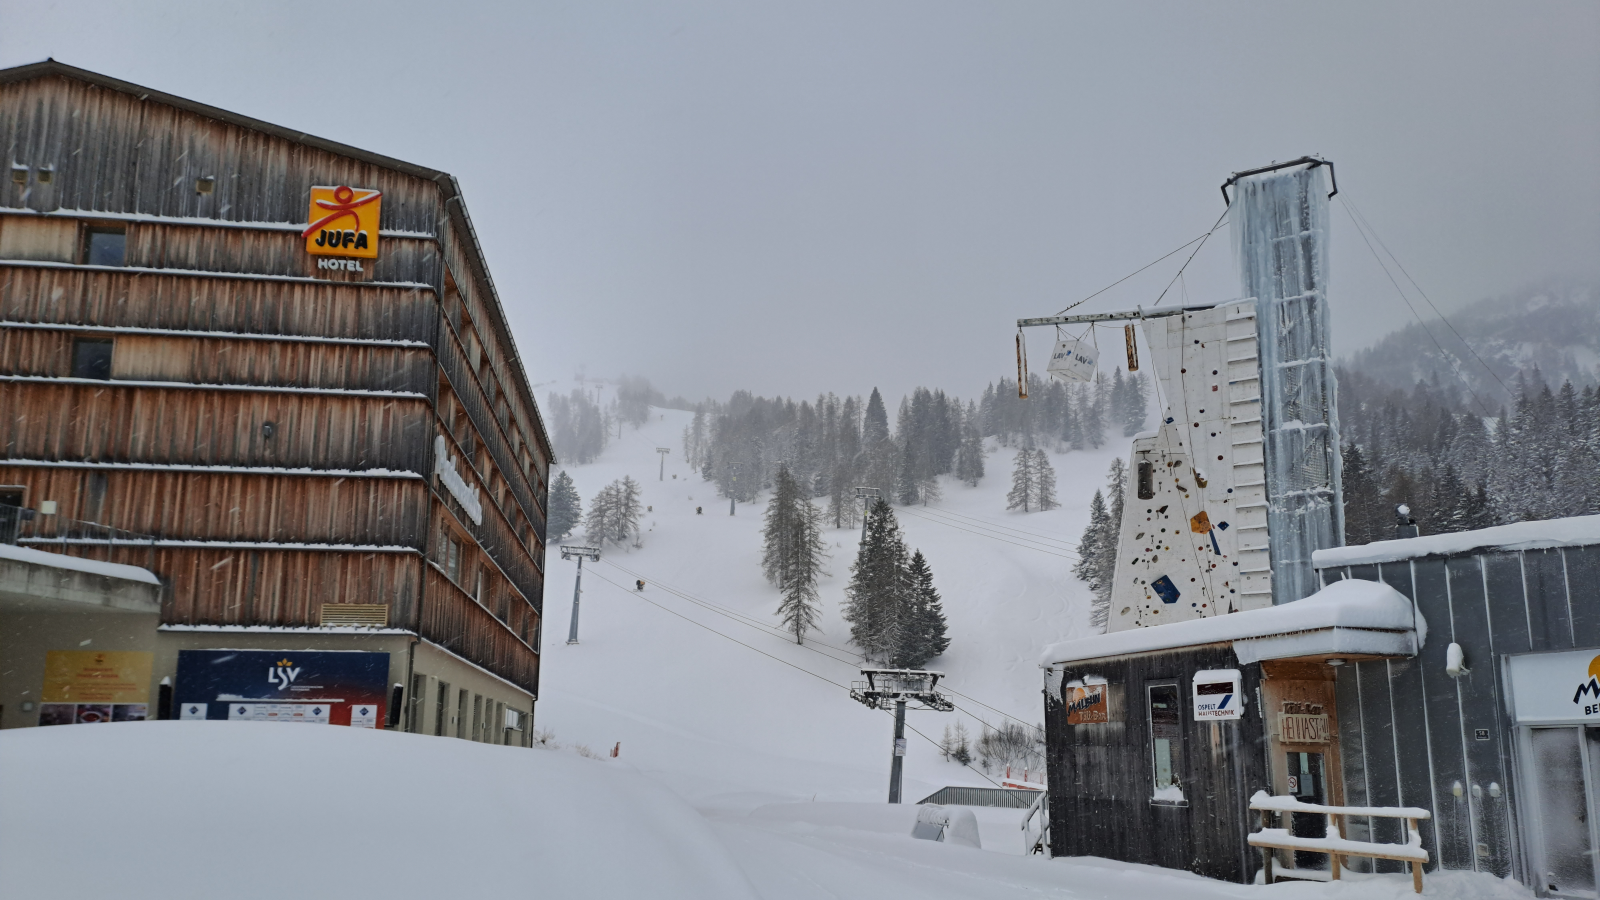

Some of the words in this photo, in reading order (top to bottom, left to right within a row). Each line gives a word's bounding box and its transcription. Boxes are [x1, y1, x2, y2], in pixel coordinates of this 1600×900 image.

[315, 229, 368, 249] JUFA
[317, 258, 363, 271] HOTEL
[1075, 353, 1087, 364] LAV
[267, 667, 300, 690] LSV
[1067, 692, 1101, 717] MALBUN
[1197, 703, 1216, 711] OSPELT
[1585, 703, 1600, 715] BE
[1198, 709, 1235, 717] HAUSTECHNIK
